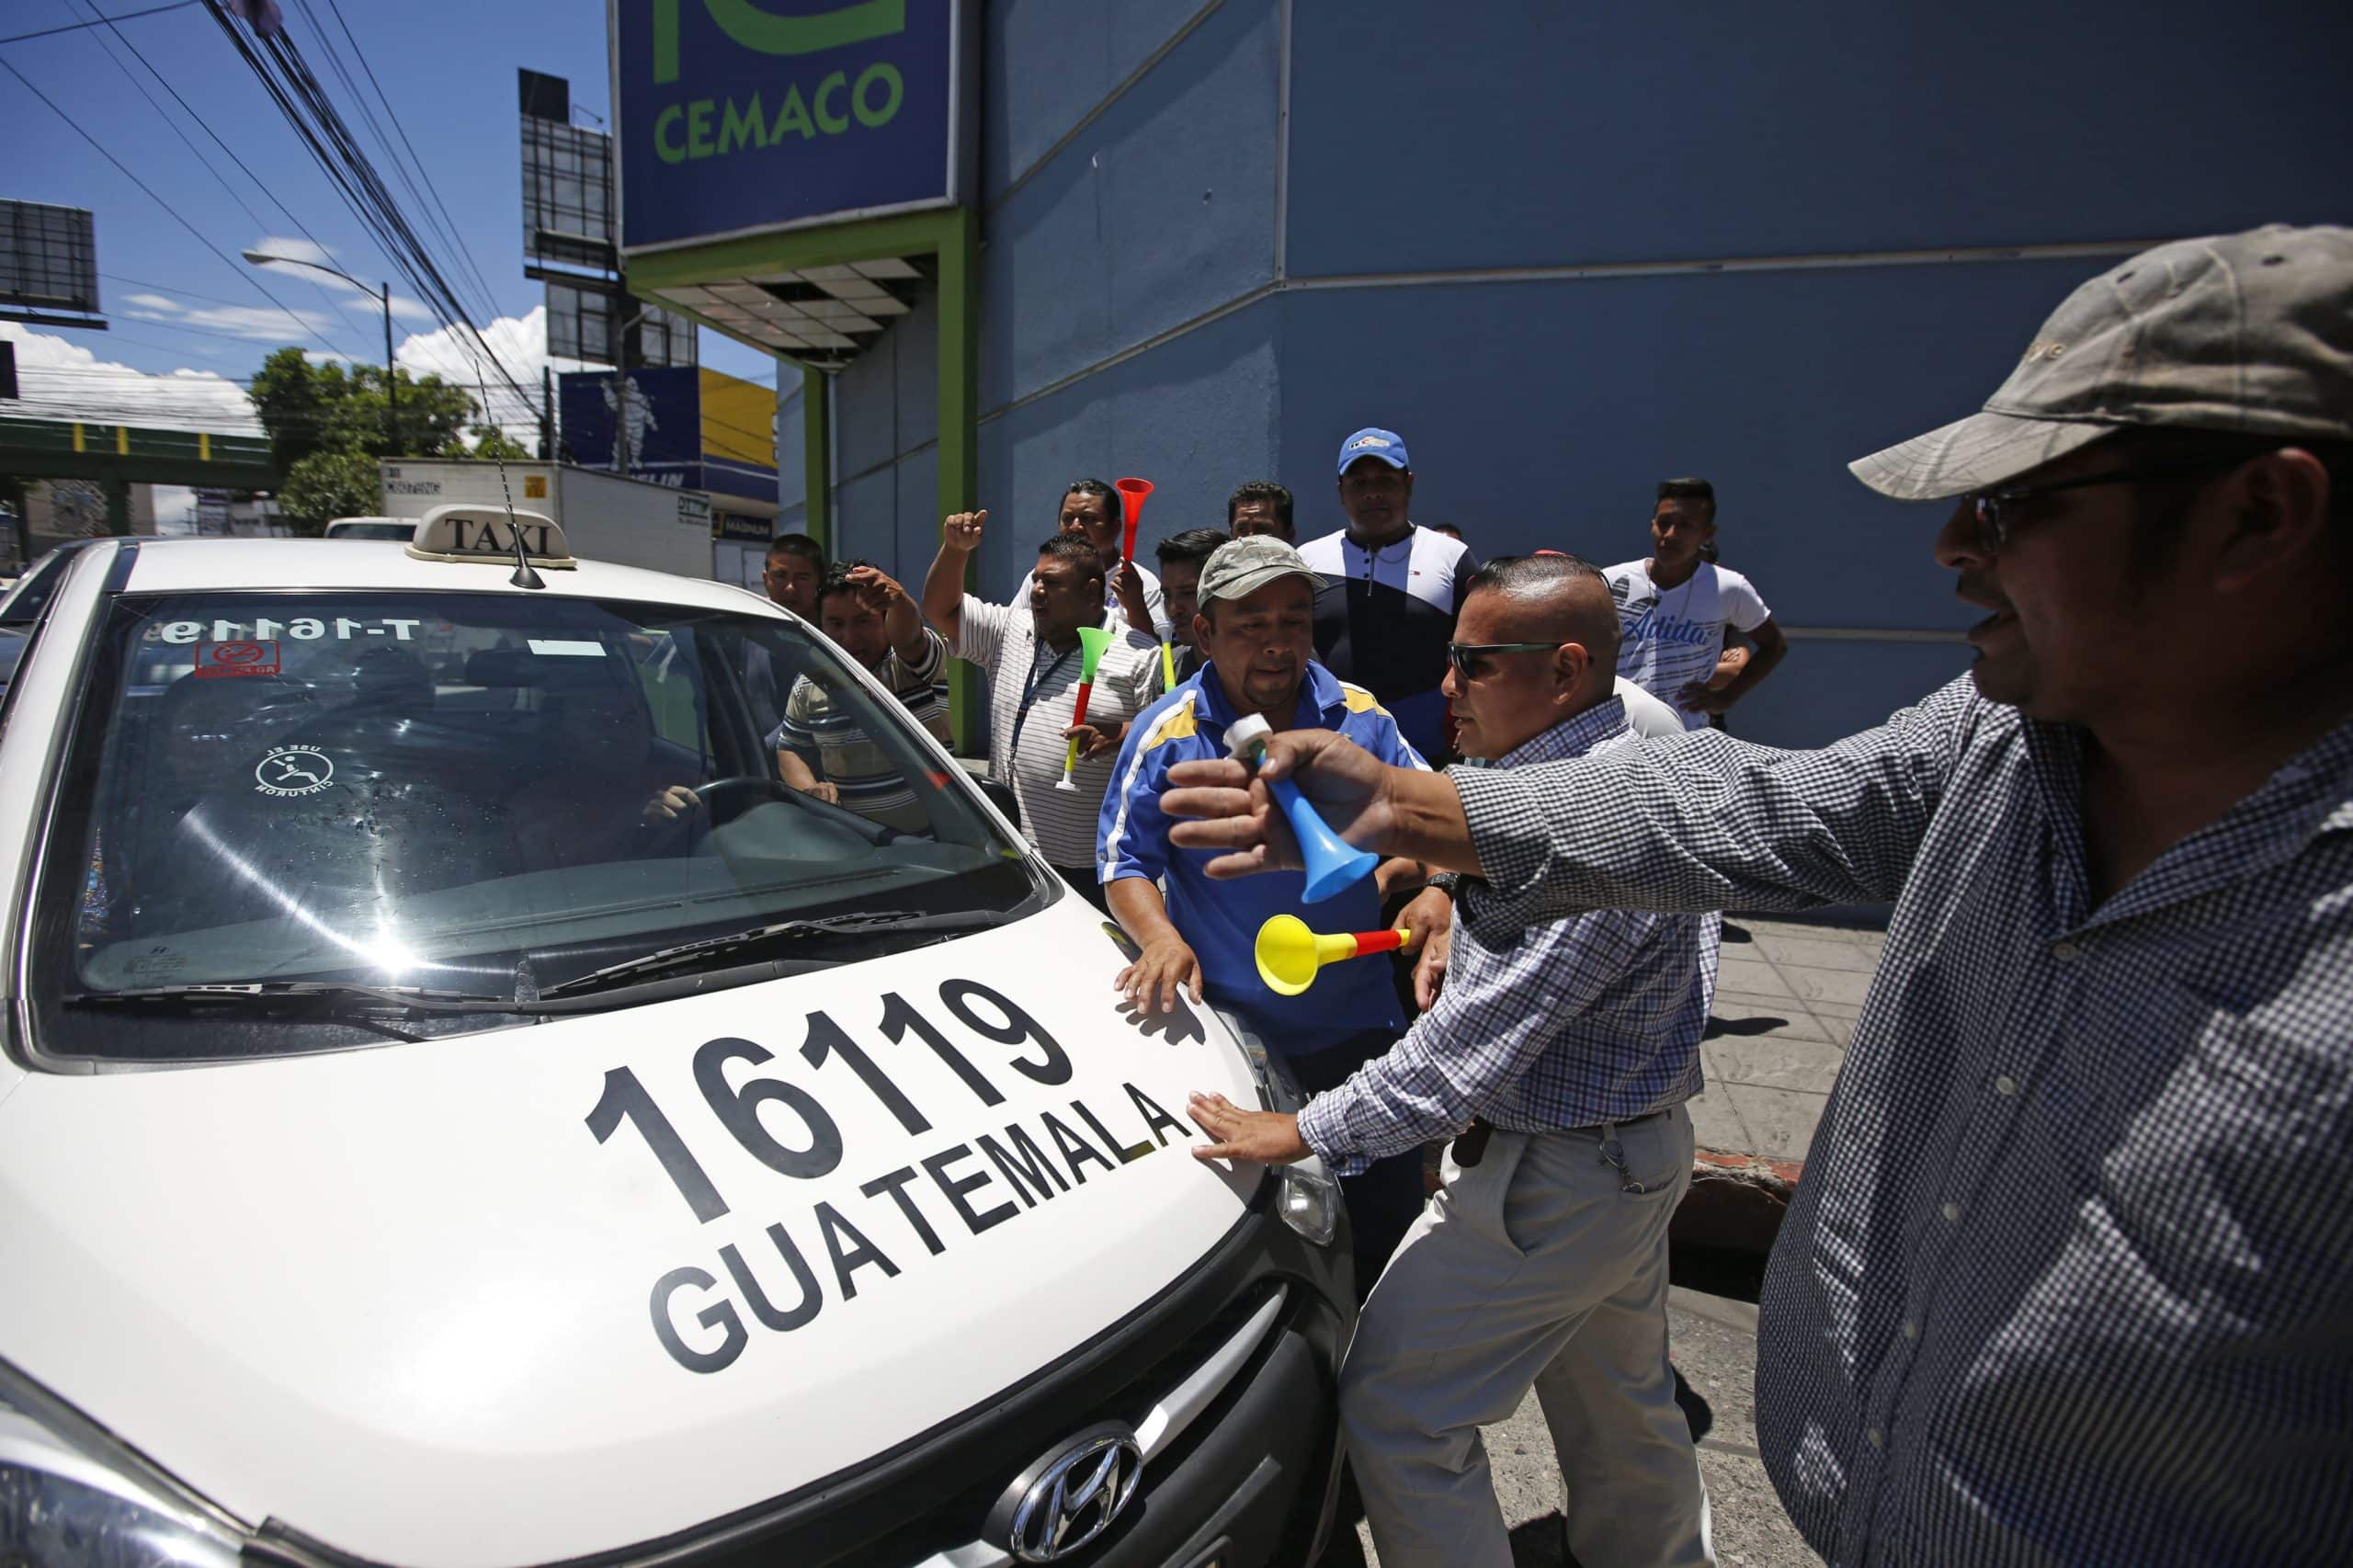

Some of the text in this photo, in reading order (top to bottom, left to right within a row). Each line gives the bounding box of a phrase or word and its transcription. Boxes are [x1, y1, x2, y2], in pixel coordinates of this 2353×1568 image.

[654, 62, 904, 164] CEMACO
[445, 518, 551, 553] TAXI
[585, 978, 1074, 1224] 16119
[649, 1082, 1191, 1375] GUATEMALA
